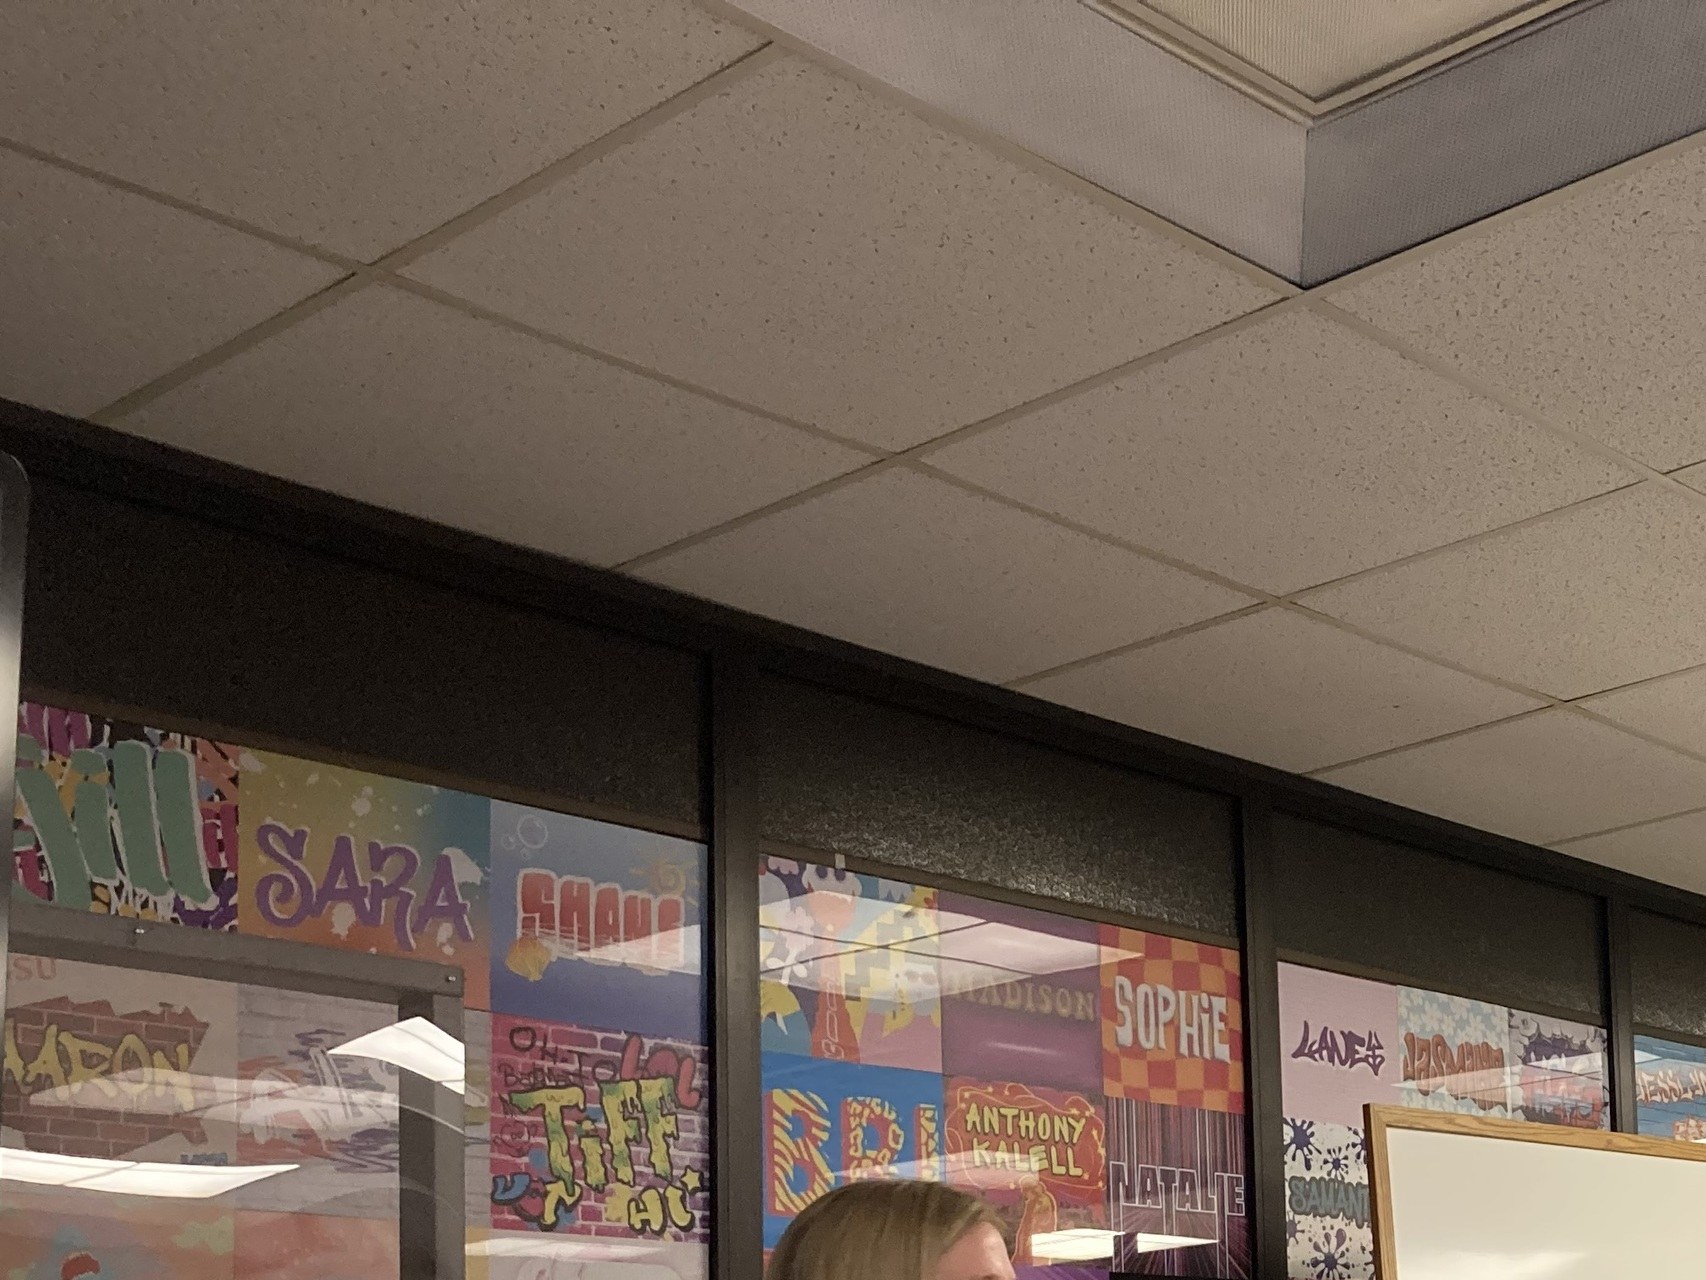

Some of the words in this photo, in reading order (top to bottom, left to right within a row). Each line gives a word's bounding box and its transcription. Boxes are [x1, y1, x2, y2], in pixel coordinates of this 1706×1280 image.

[254, 820, 474, 952] SARA
[1291, 1020, 1385, 1076] LANEY
[963, 1105, 1086, 1147] ANTHONY
[970, 1138, 1085, 1178] KALELL
[1110, 1160, 1246, 1217] NATALIE
